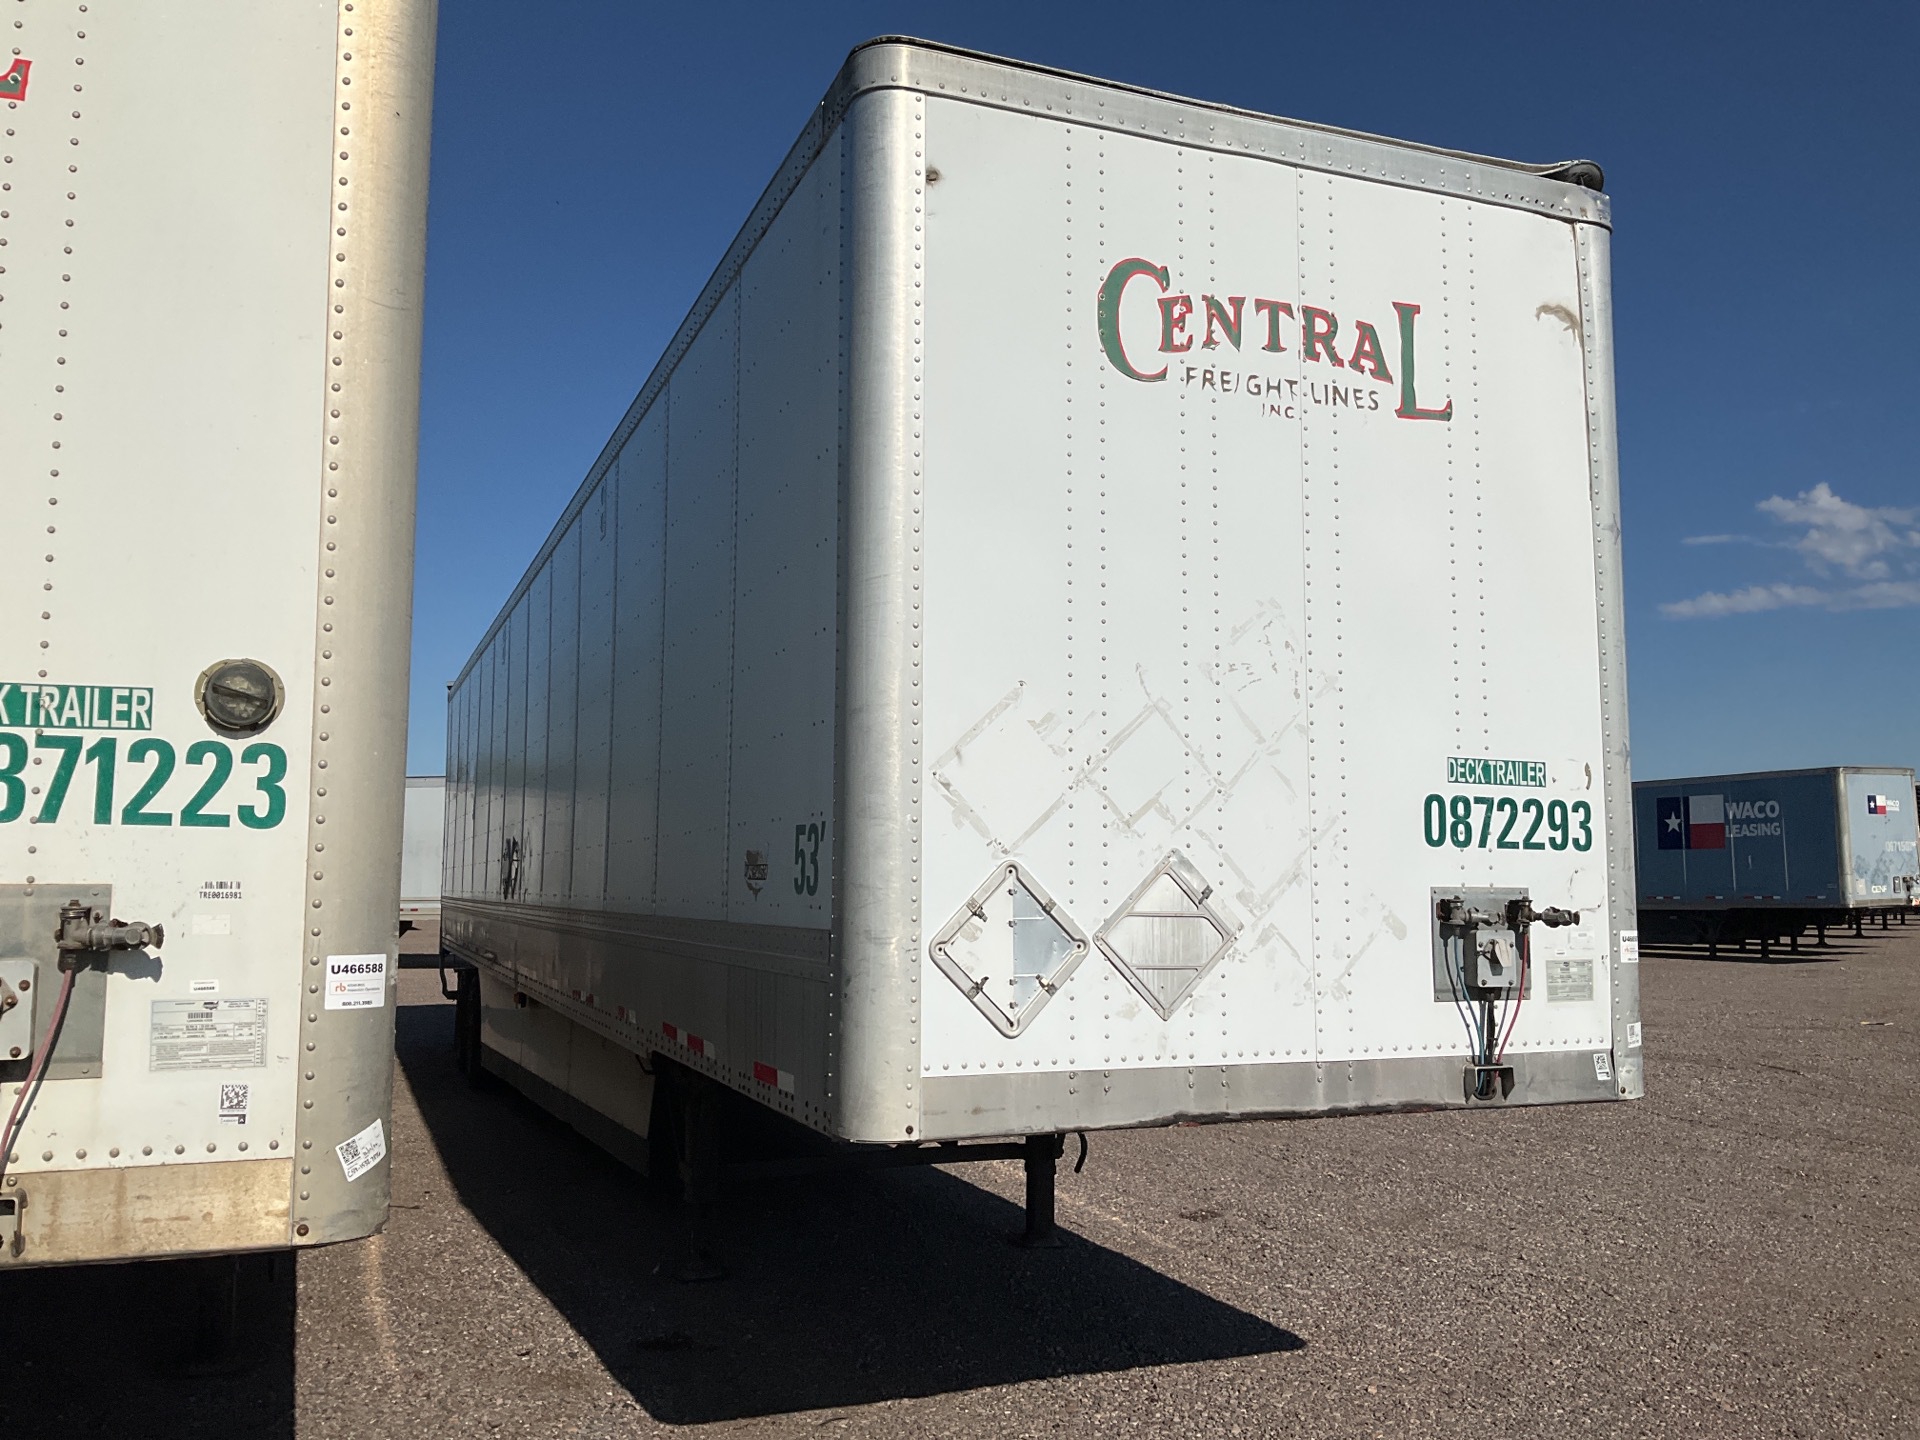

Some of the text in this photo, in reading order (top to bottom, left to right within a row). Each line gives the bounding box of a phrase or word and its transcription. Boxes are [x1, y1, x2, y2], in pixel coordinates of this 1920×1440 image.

[1098, 257, 1453, 421] CENTRAL
[1186, 366, 1379, 411] FREIGHT LINES
[20, 685, 151, 729] TRAILER
[1448, 757, 1546, 787] DECK TRAILER
[1423, 793, 1593, 852] 0872293
[1725, 800, 1780, 819] WACO
[1725, 822, 1781, 838] LEASING
[793, 820, 826, 896] 53'
[331, 963, 383, 974] U466588
